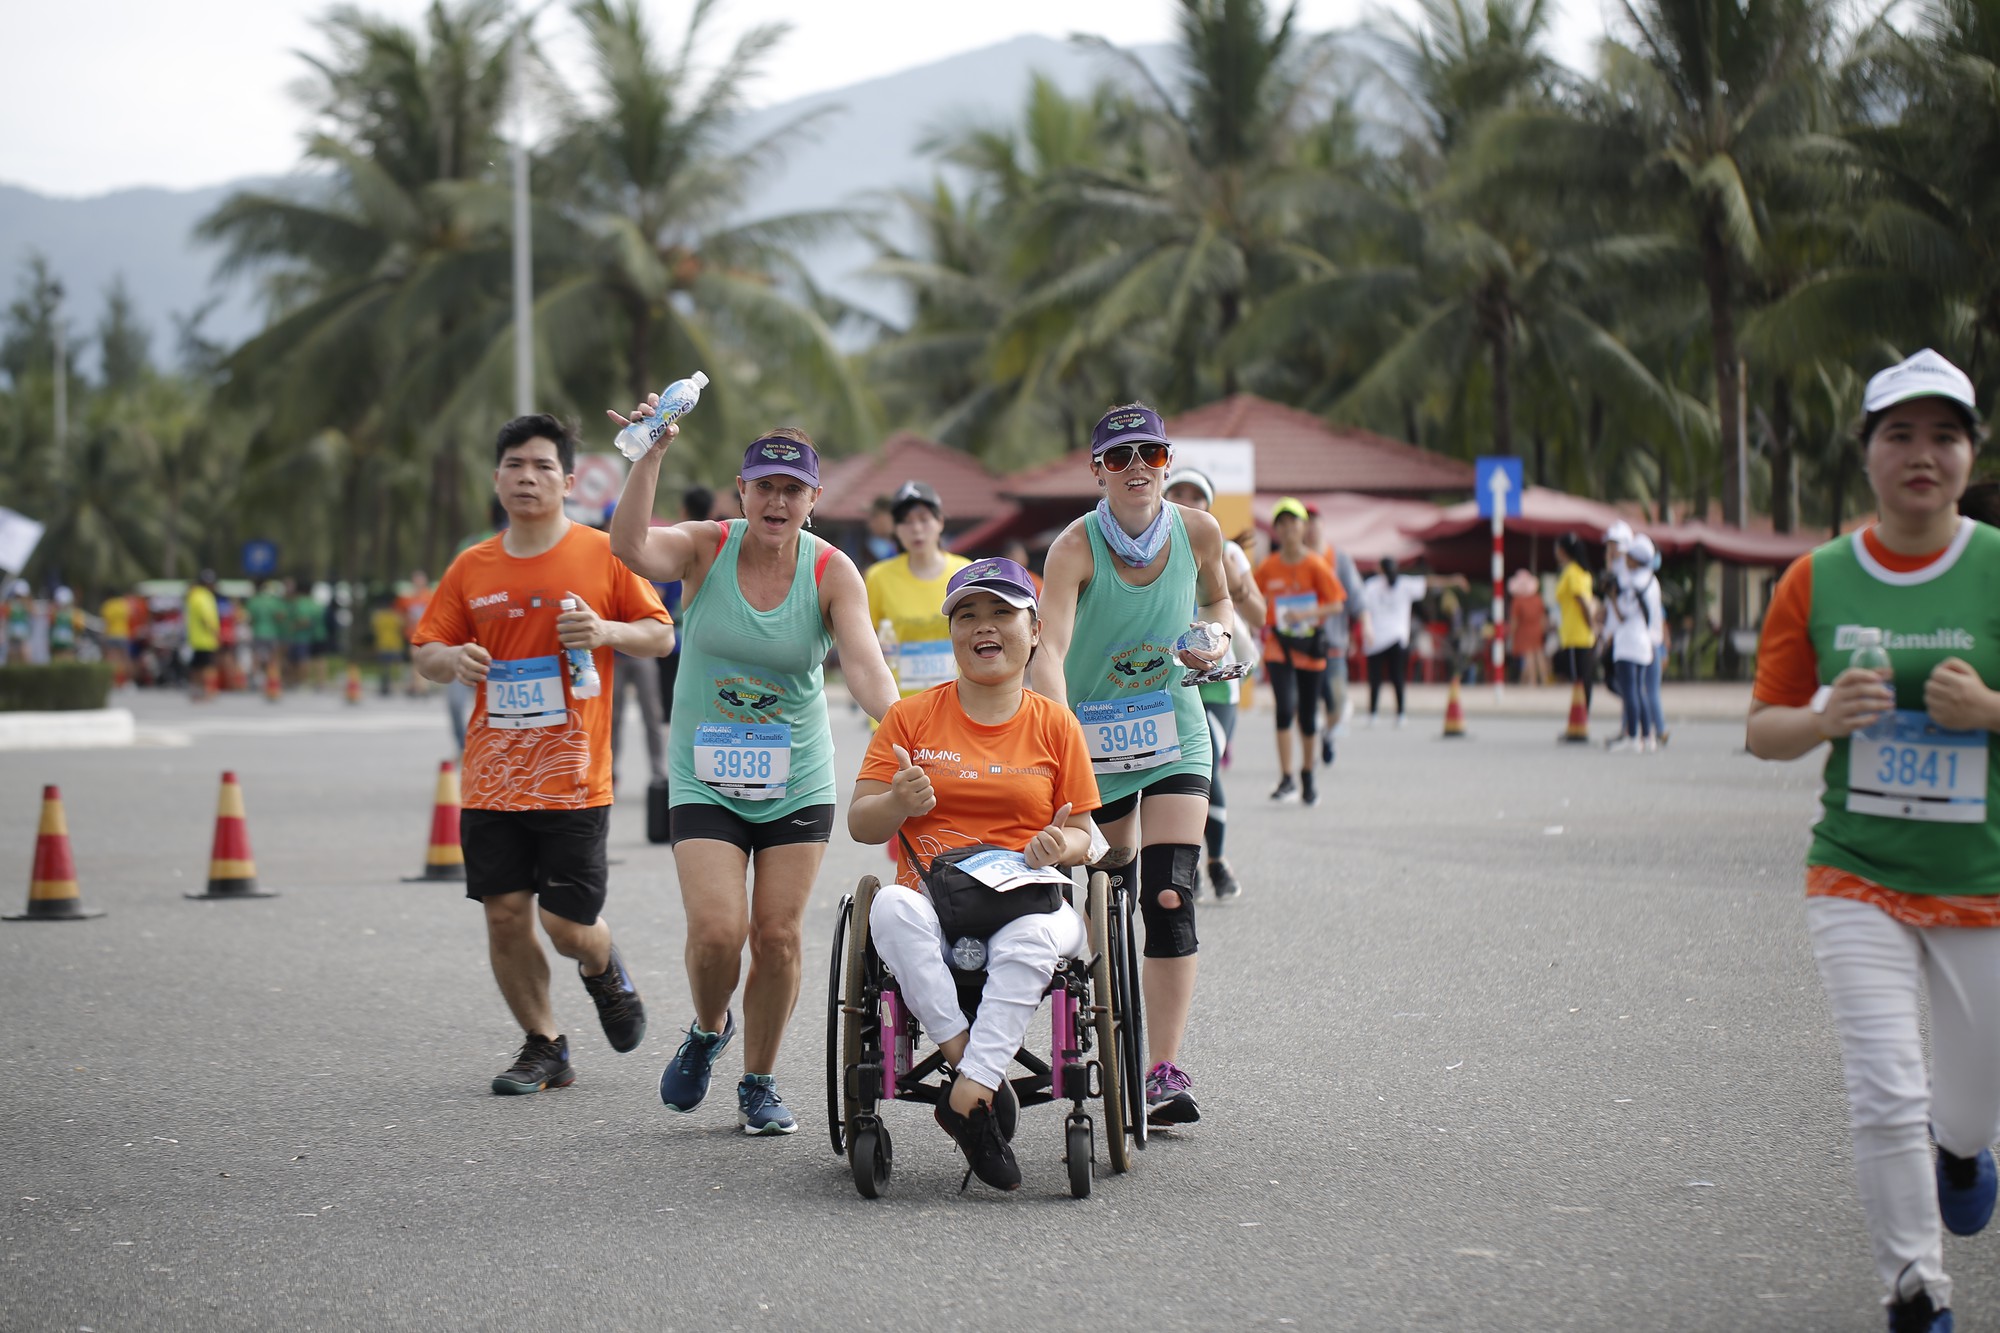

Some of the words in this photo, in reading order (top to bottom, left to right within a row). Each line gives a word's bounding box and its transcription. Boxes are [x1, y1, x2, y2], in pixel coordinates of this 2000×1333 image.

[649, 402, 690, 441] Revive
[469, 591, 508, 609] DANANG
[1112, 647, 1138, 662] born
[1142, 642, 1152, 652] to
[715, 677, 744, 688] born
[750, 676, 762, 686] to
[766, 682, 785, 696] run
[1144, 668, 1168, 686] give
[496, 682, 545, 709] 2454
[1084, 703, 1112, 712] DANANG
[1136, 700, 1165, 712] Manulife
[740, 714, 754, 724] to
[1099, 719, 1158, 753] 3948
[714, 750, 772, 778] 3938
[913, 748, 960, 762] DANANG
[960, 770, 978, 780] 2018
[1877, 745, 1960, 790] 3841
